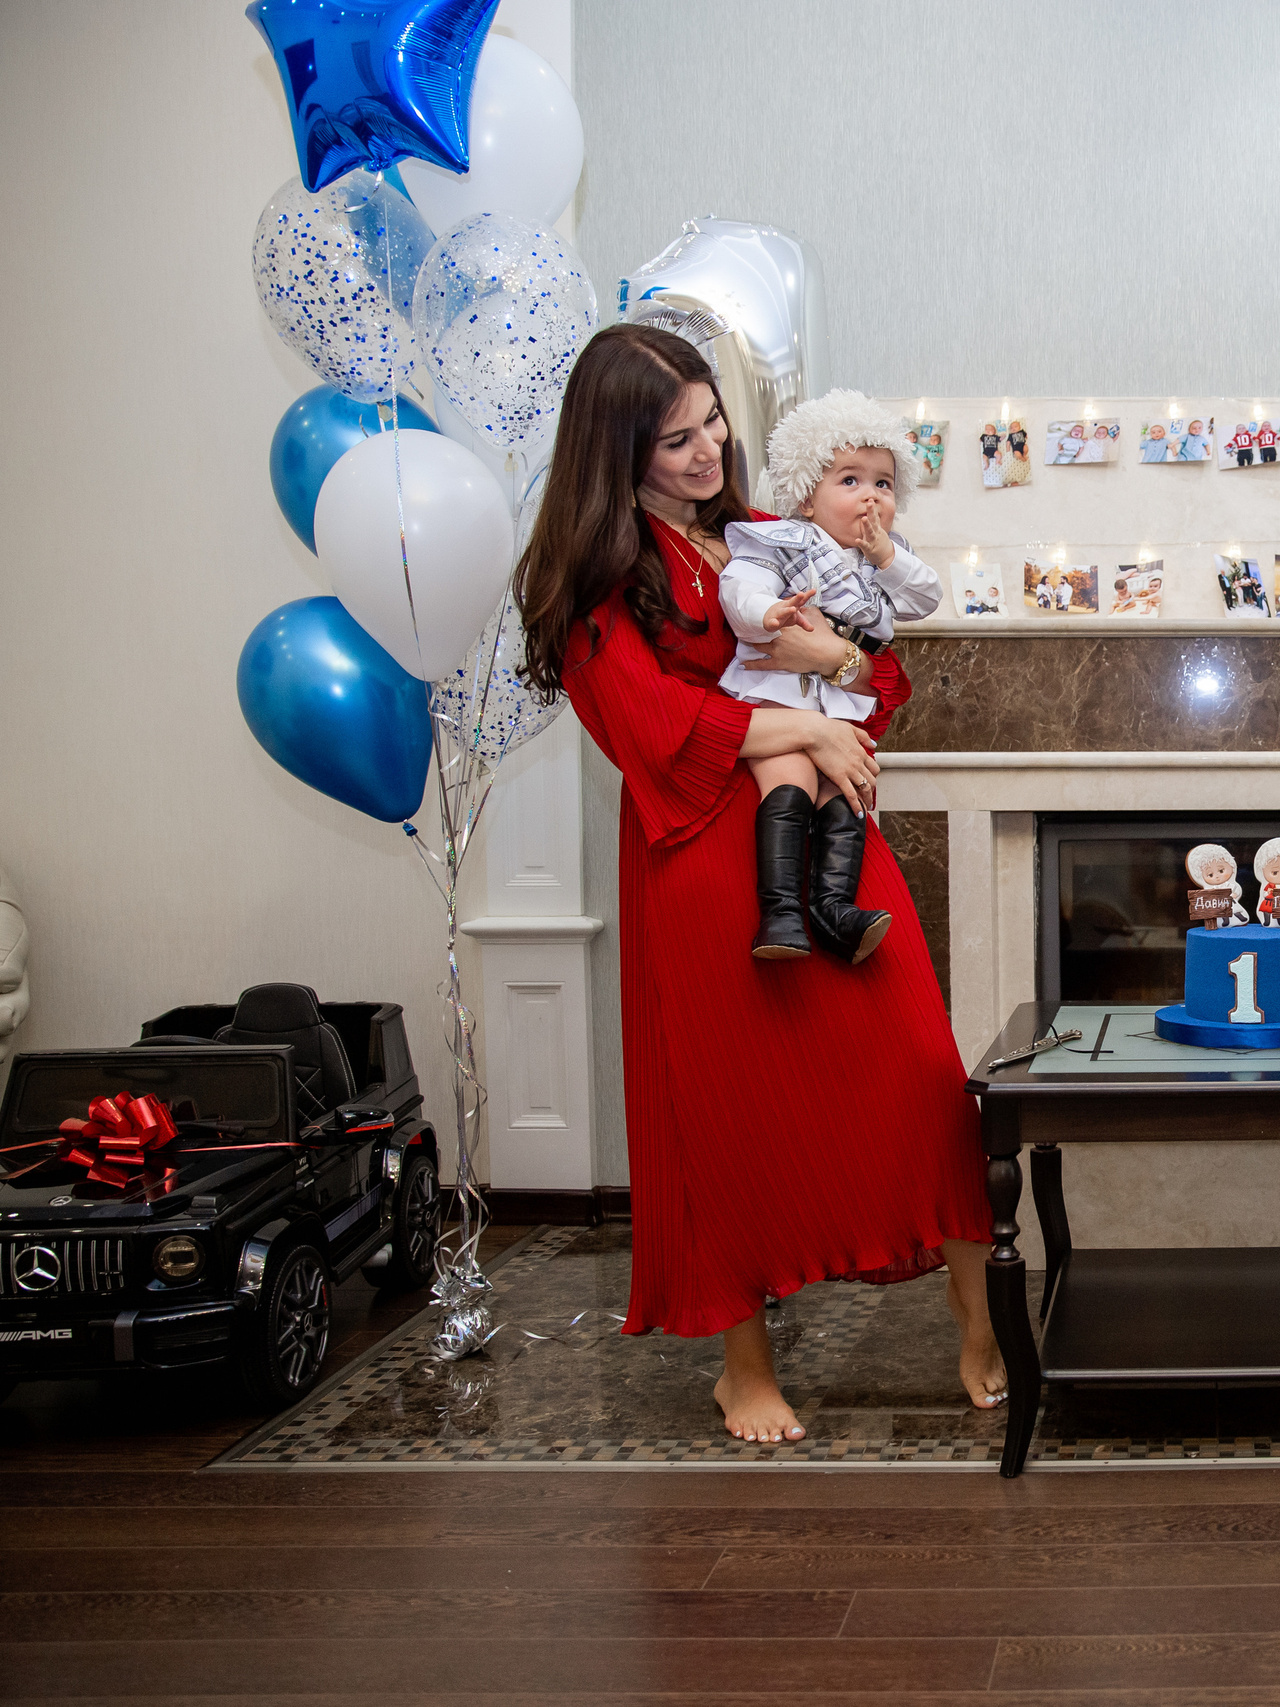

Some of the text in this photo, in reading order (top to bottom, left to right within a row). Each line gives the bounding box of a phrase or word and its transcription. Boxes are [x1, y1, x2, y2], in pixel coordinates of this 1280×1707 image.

[1236, 435, 1249, 446] 10
[1261, 433, 1273, 445] 10
[1228, 951, 1265, 1024] 1
